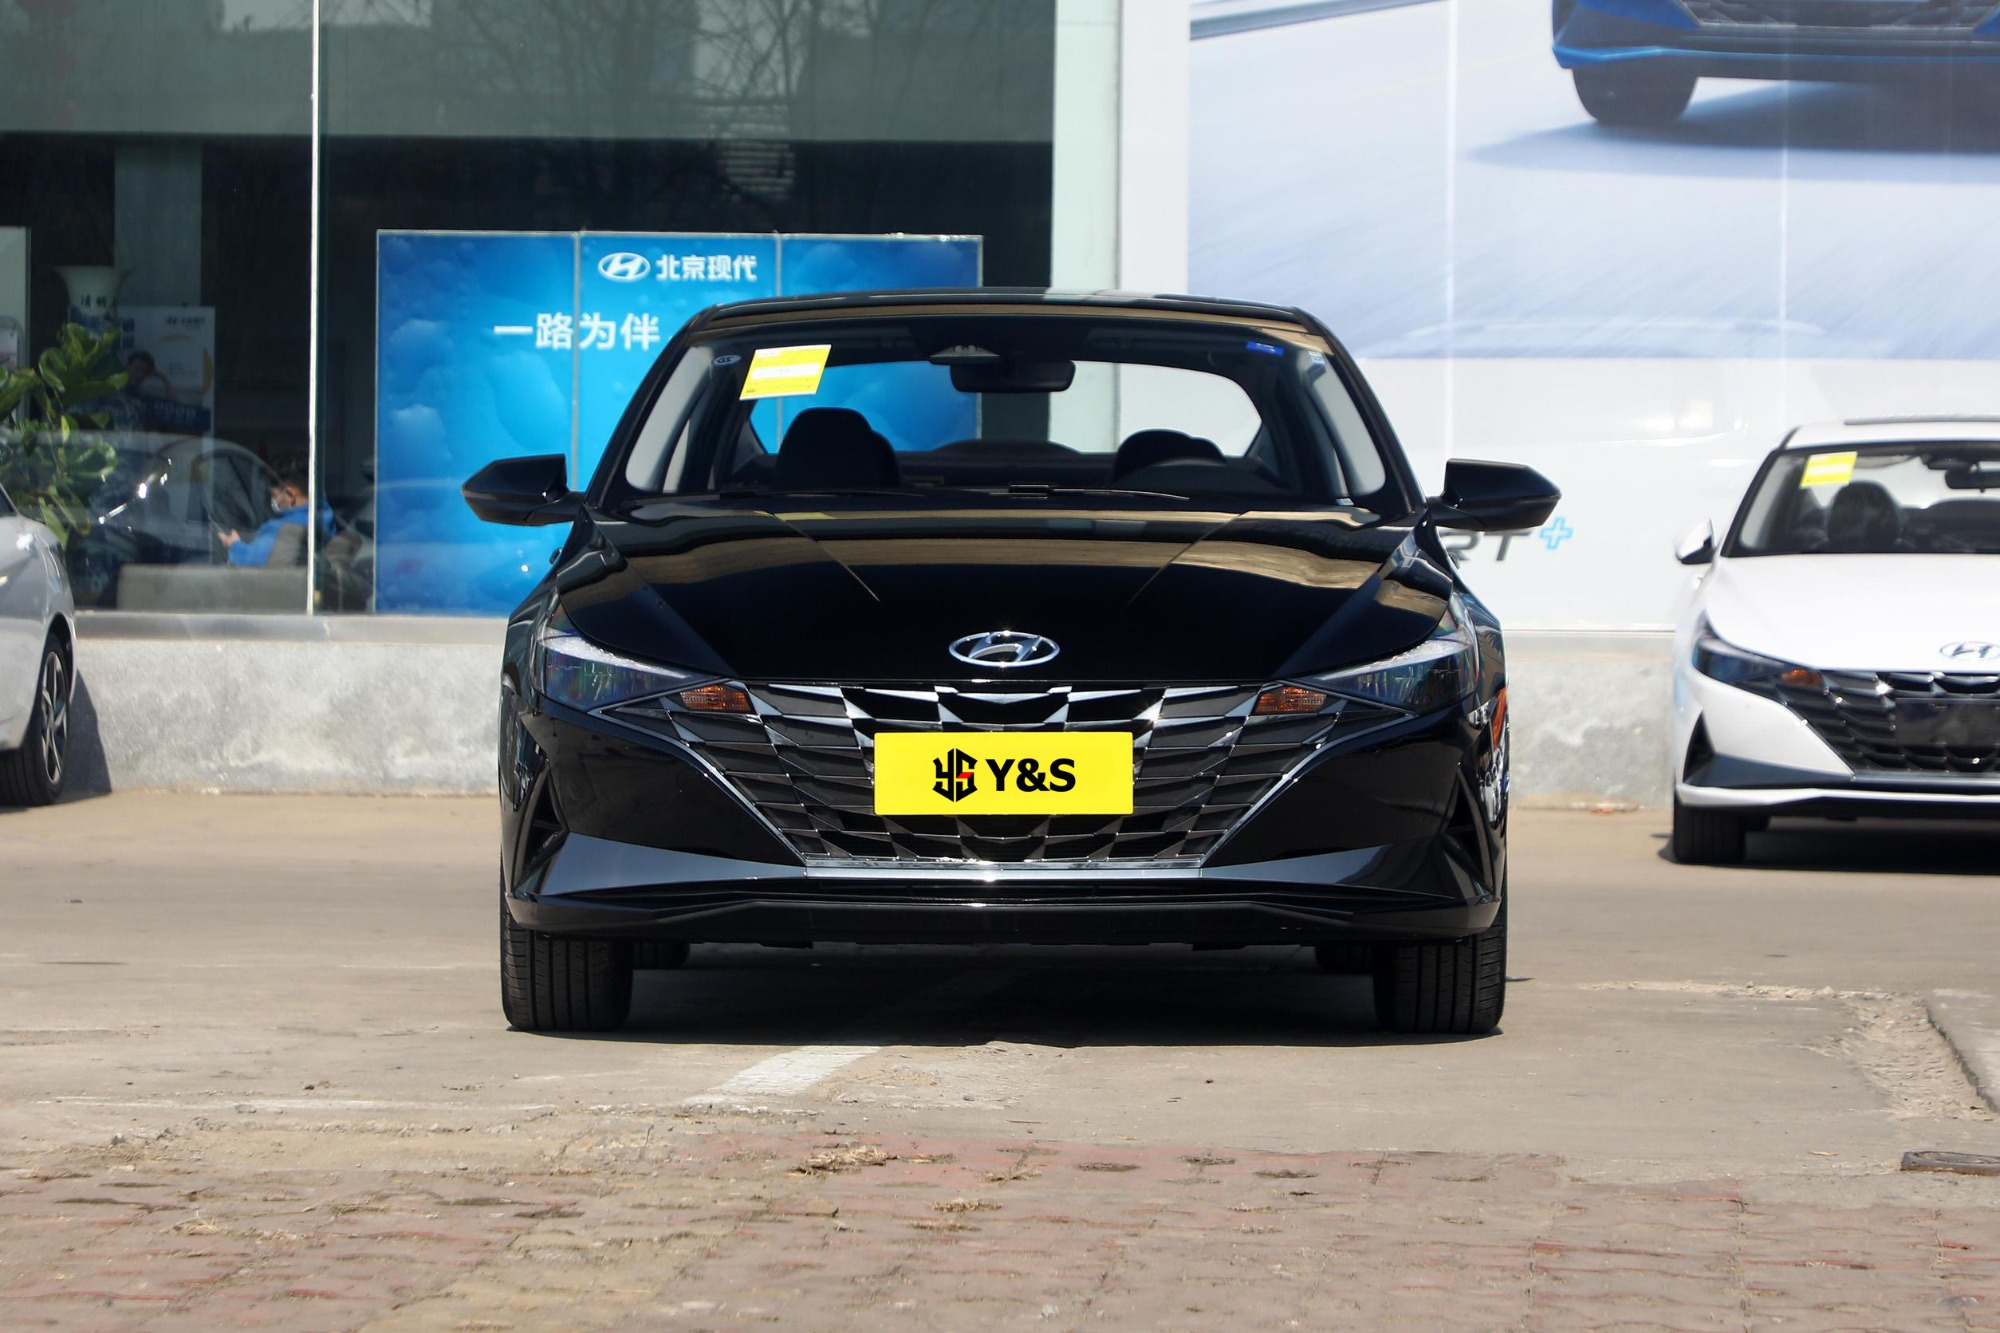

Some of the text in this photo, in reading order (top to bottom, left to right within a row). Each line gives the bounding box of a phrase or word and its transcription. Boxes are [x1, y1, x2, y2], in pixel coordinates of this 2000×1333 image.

[656, 254, 758, 282] 北京现代
[493, 312, 661, 350] 一路为伴
